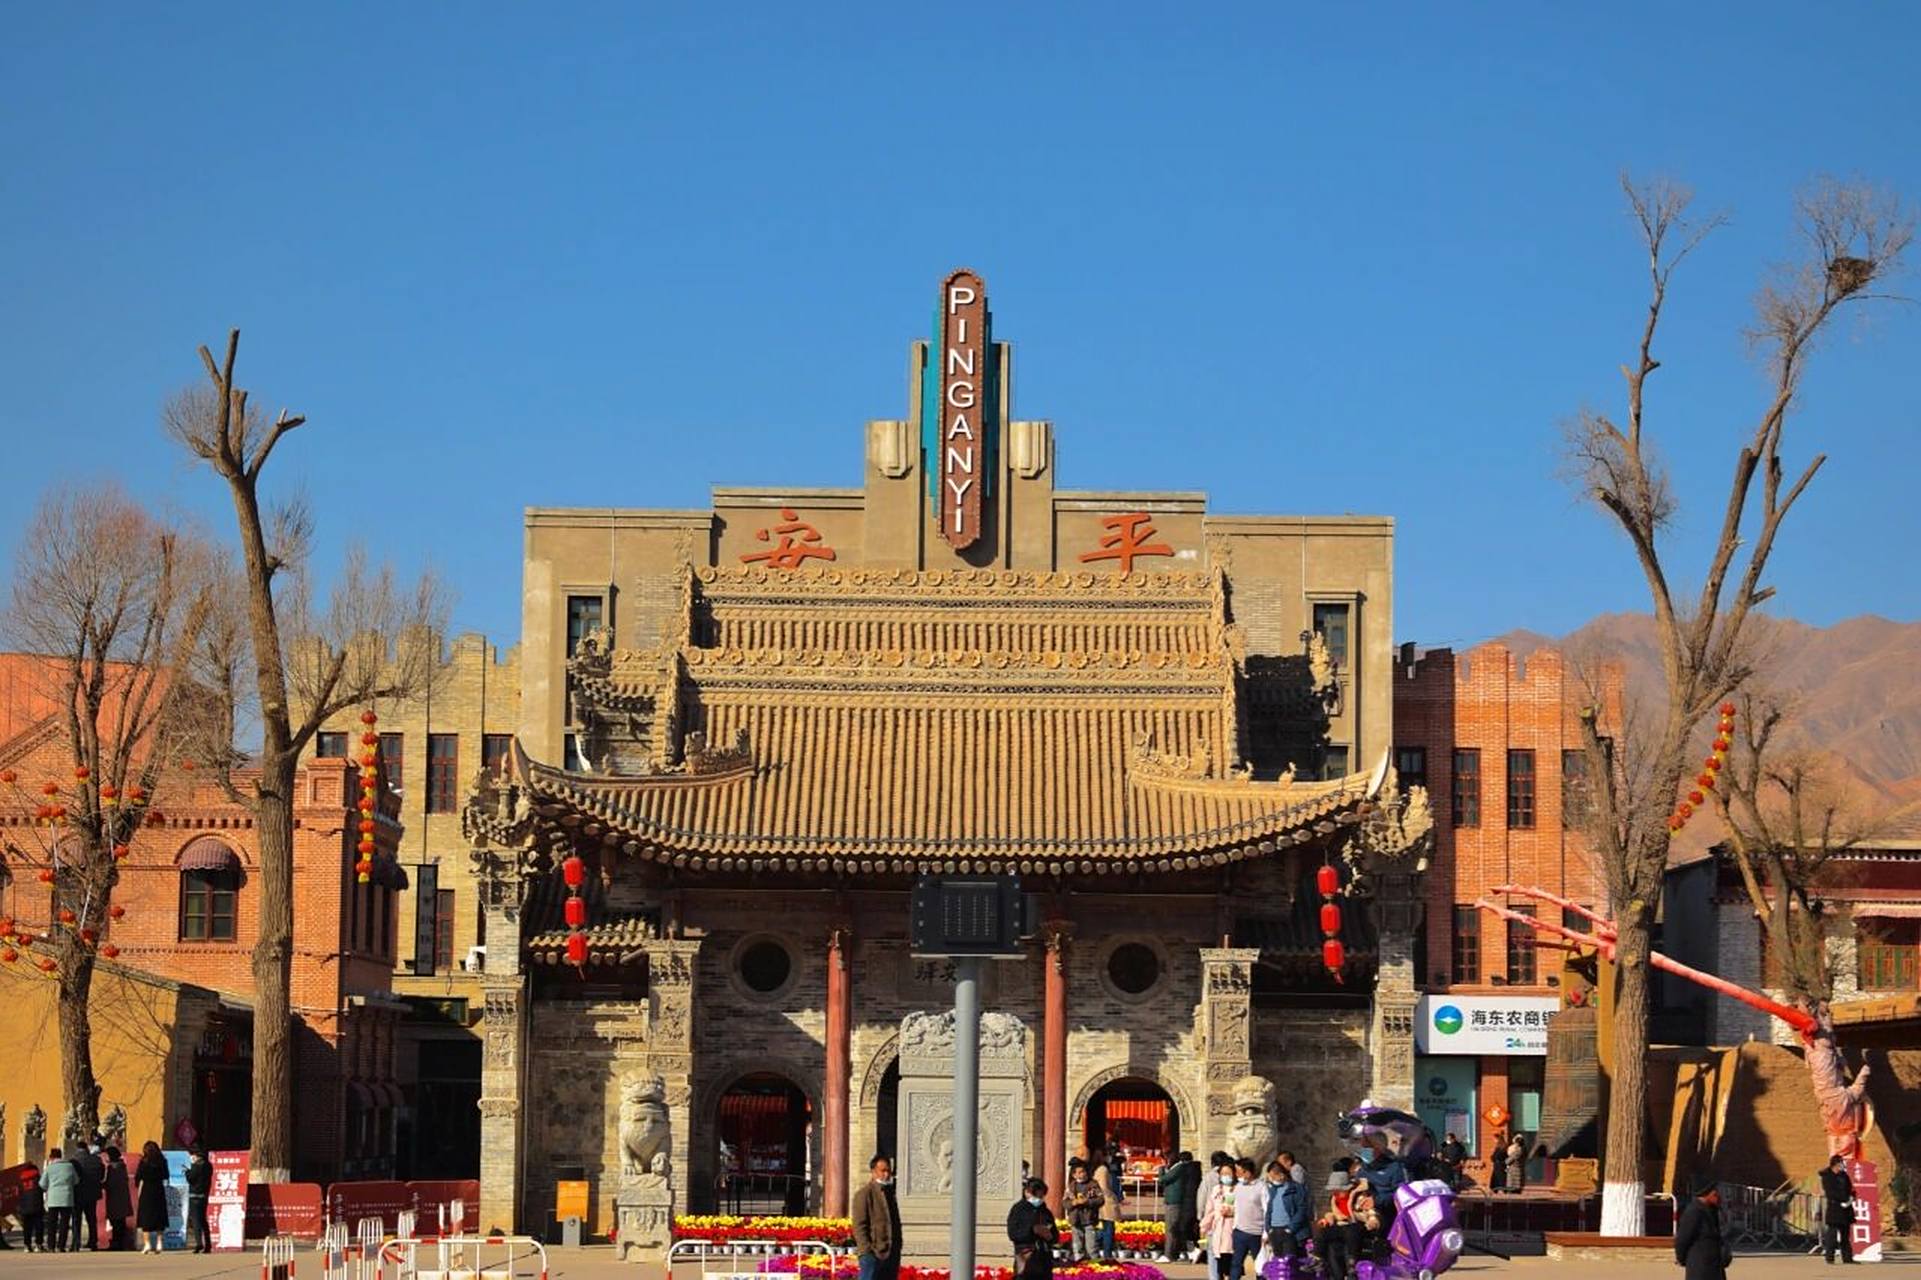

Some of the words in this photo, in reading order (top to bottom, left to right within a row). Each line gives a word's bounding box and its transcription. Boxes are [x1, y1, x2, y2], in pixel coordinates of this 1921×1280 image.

[947, 286, 977, 535] PINGANYI
[740, 507, 836, 571] 安
[1079, 512, 1175, 574] 平
[1852, 1198, 1871, 1244] 出口
